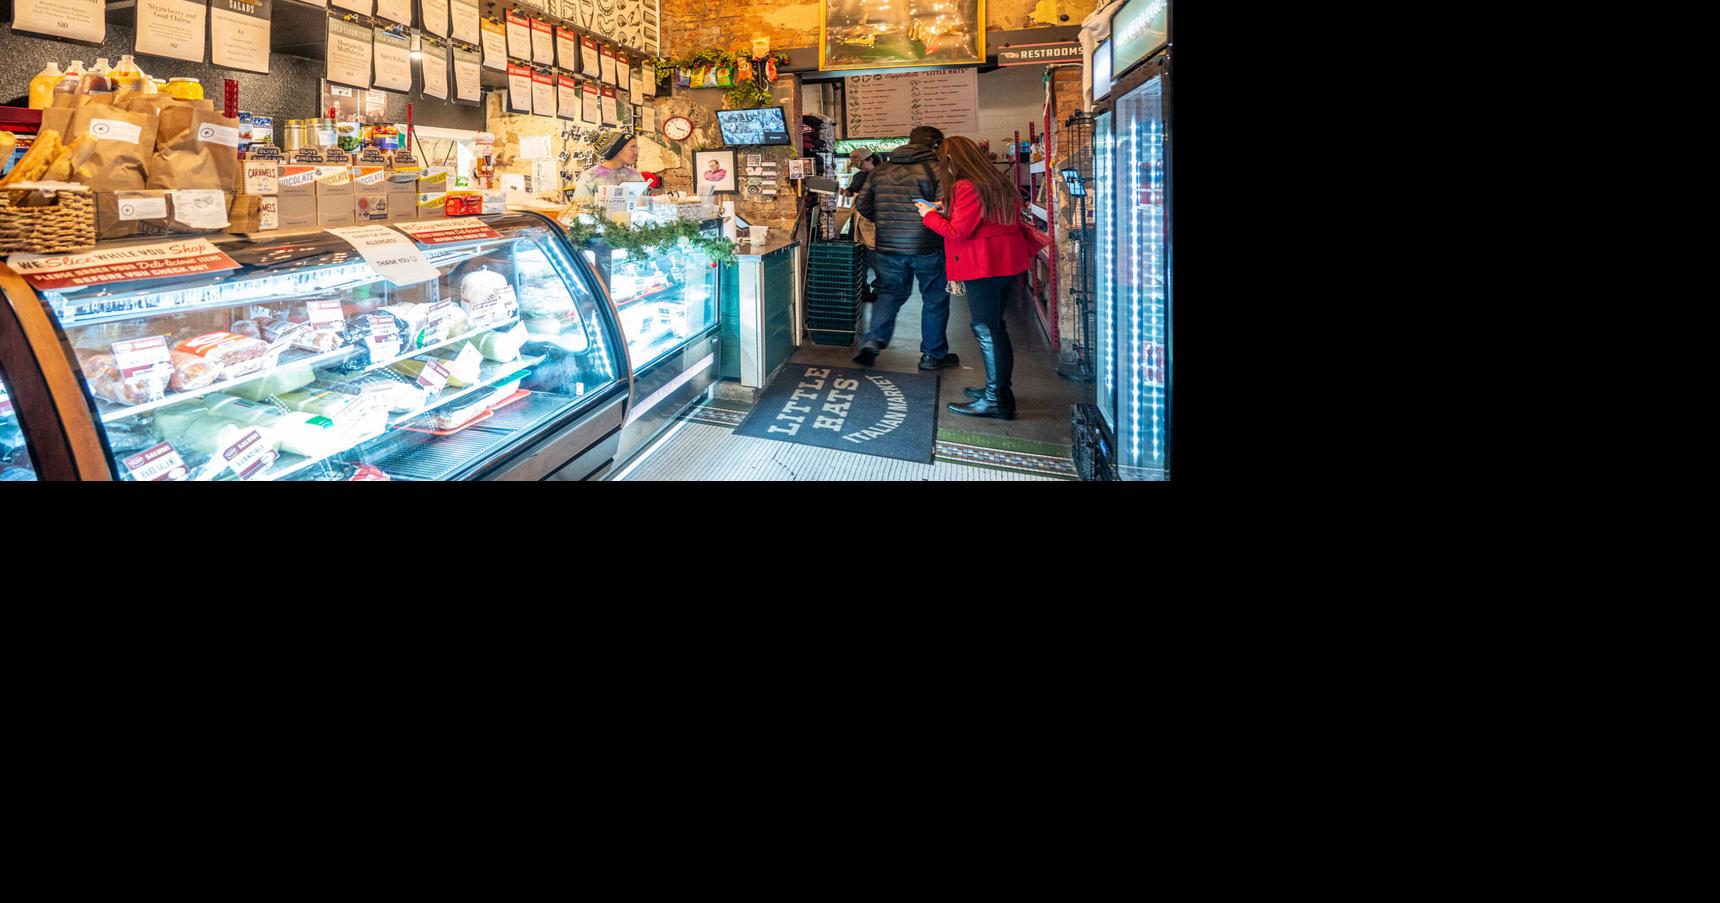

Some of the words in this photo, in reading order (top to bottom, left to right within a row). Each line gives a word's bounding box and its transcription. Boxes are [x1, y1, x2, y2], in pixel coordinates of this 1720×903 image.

[229, 0, 255, 13] SALADS
[1020, 46, 1084, 59] RESTROOMS
[248, 168, 276, 179] CARAMELS
[17, 260, 43, 270] WE
[45, 256, 95, 268] Slice
[94, 249, 138, 262] WHILE
[138, 247, 166, 256] YOU
[168, 243, 206, 255] Shop
[33, 271, 76, 281] PLEASE
[74, 266, 110, 276] ORDER
[109, 262, 137, 272] YOUR
[196, 254, 222, 264] ITEMS
[72, 272, 125, 284] BEFORE
[124, 269, 151, 279] YOU
[150, 266, 189, 276] CHECK
[188, 263, 209, 272] OUT
[767, 367, 831, 436] LITTLE
[864, 375, 908, 412] MARKET
[841, 411, 907, 444] ITALIAN
